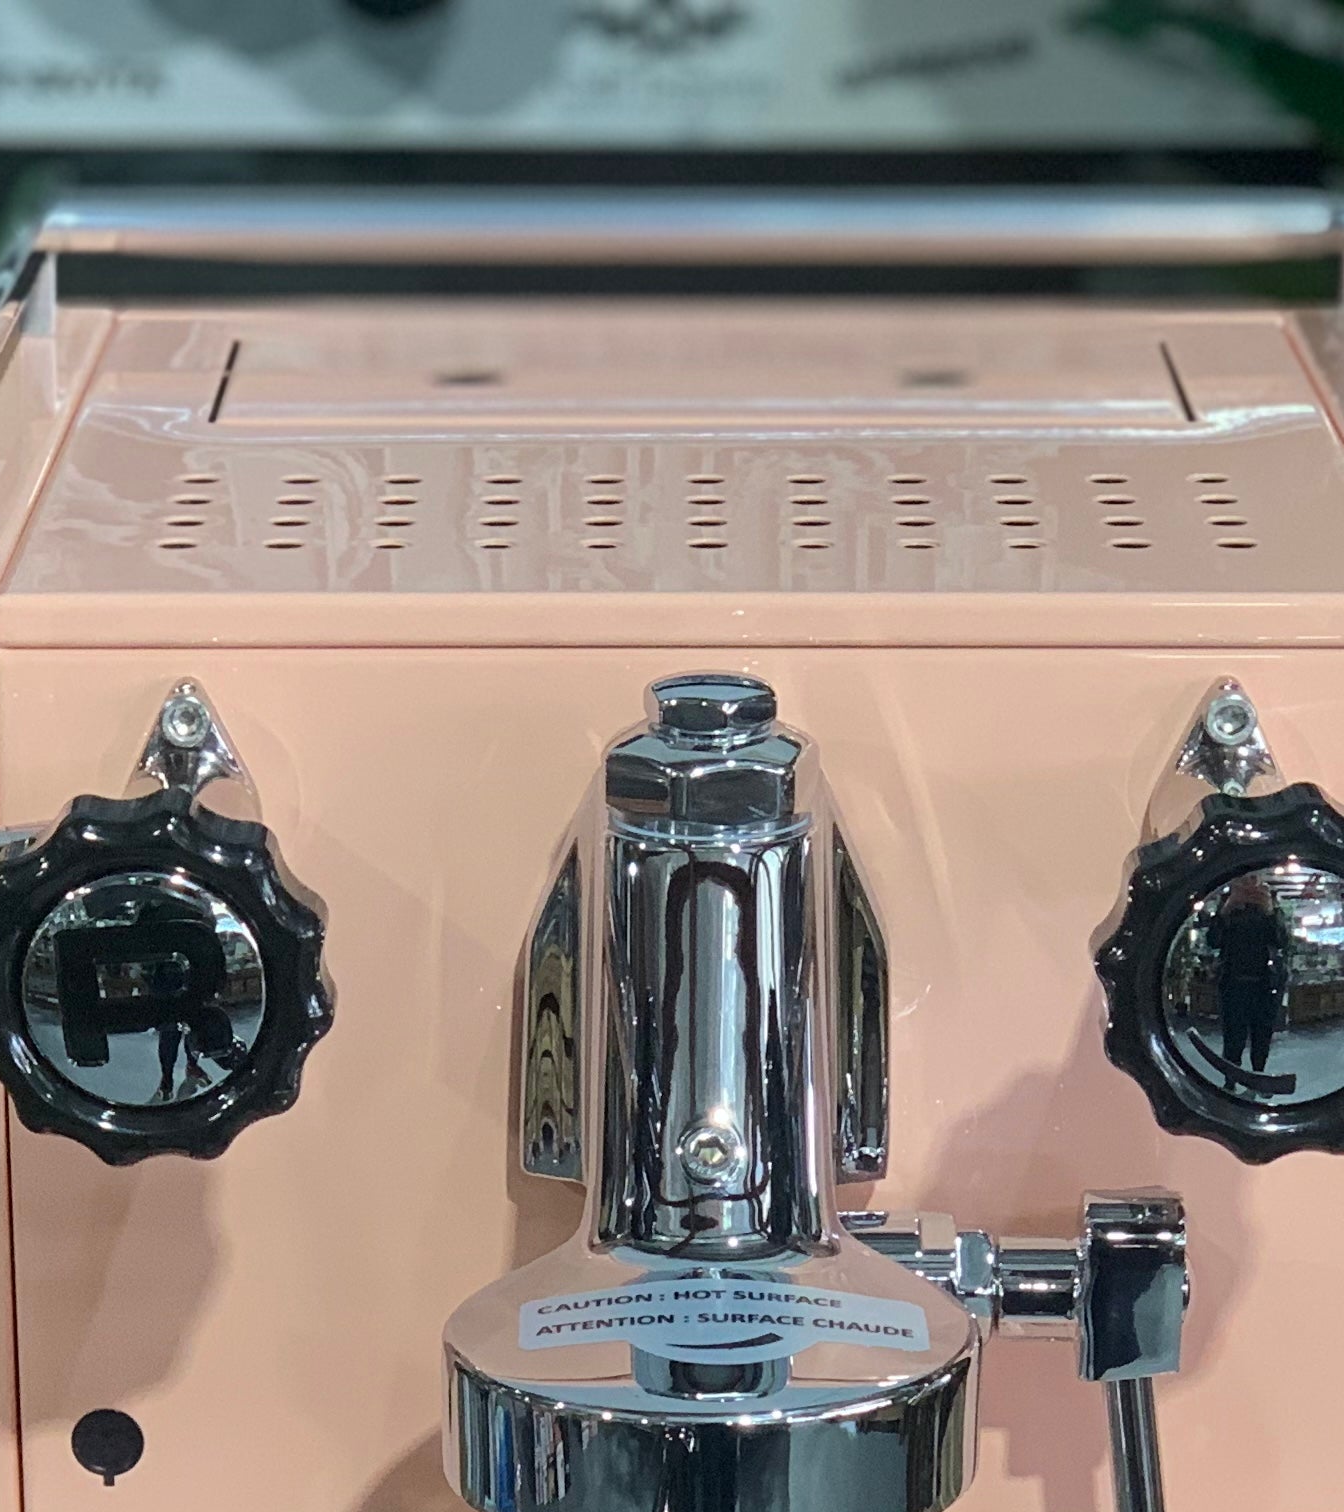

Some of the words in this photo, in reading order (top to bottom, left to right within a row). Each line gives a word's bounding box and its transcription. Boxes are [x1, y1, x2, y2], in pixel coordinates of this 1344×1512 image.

[537, 1292, 653, 1316] CAUTION
[673, 1289, 727, 1301] HOT
[732, 1289, 843, 1309] SURFACE
[535, 1312, 675, 1337] ATTENTION
[697, 1312, 805, 1327] SURFACE
[811, 1317, 915, 1339] CHAUDE
